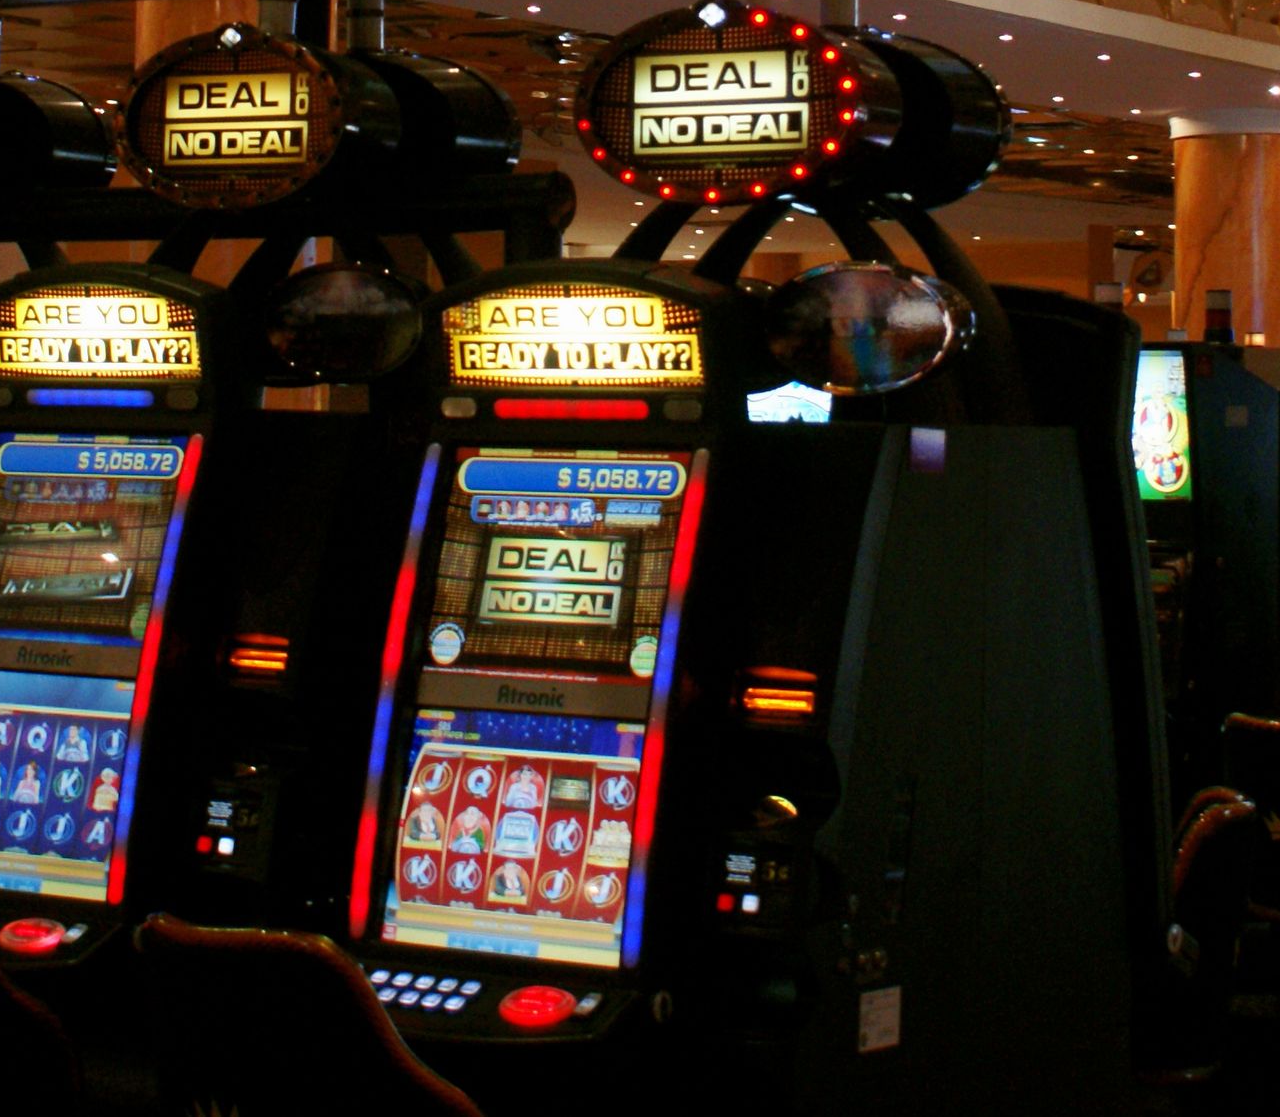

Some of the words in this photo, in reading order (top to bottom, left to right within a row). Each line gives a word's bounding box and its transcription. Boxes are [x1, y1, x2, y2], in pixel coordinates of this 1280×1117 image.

[649, 58, 773, 94] DEAL
[793, 48, 810, 97] OR
[177, 81, 279, 110] DEAL
[295, 72, 309, 115] OR
[169, 130, 216, 158] NO
[219, 127, 301, 155] DEAL
[641, 115, 698, 147] NO
[703, 111, 802, 143] DEAL
[21, 304, 85, 326] ARE
[95, 304, 162, 326] YOU
[486, 304, 561, 329] ARE
[577, 304, 657, 330] YOU
[1, 339, 72, 364] READY
[74, 339, 106, 364] TO
[108, 339, 192, 364] PLAY??
[462, 341, 547, 370] READY
[551, 342, 588, 370] TO
[592, 342, 693, 371] PLAY??
[77, 450, 91, 470] $
[93, 451, 173, 472] 5,058.72
[557, 469, 571, 489] $
[576, 469, 672, 491] 5,058.72
[496, 544, 599, 575] DEAL
[488, 587, 533, 614] NO
[535, 589, 611, 618] DEAL
[496, 685, 565, 709] Atronic
